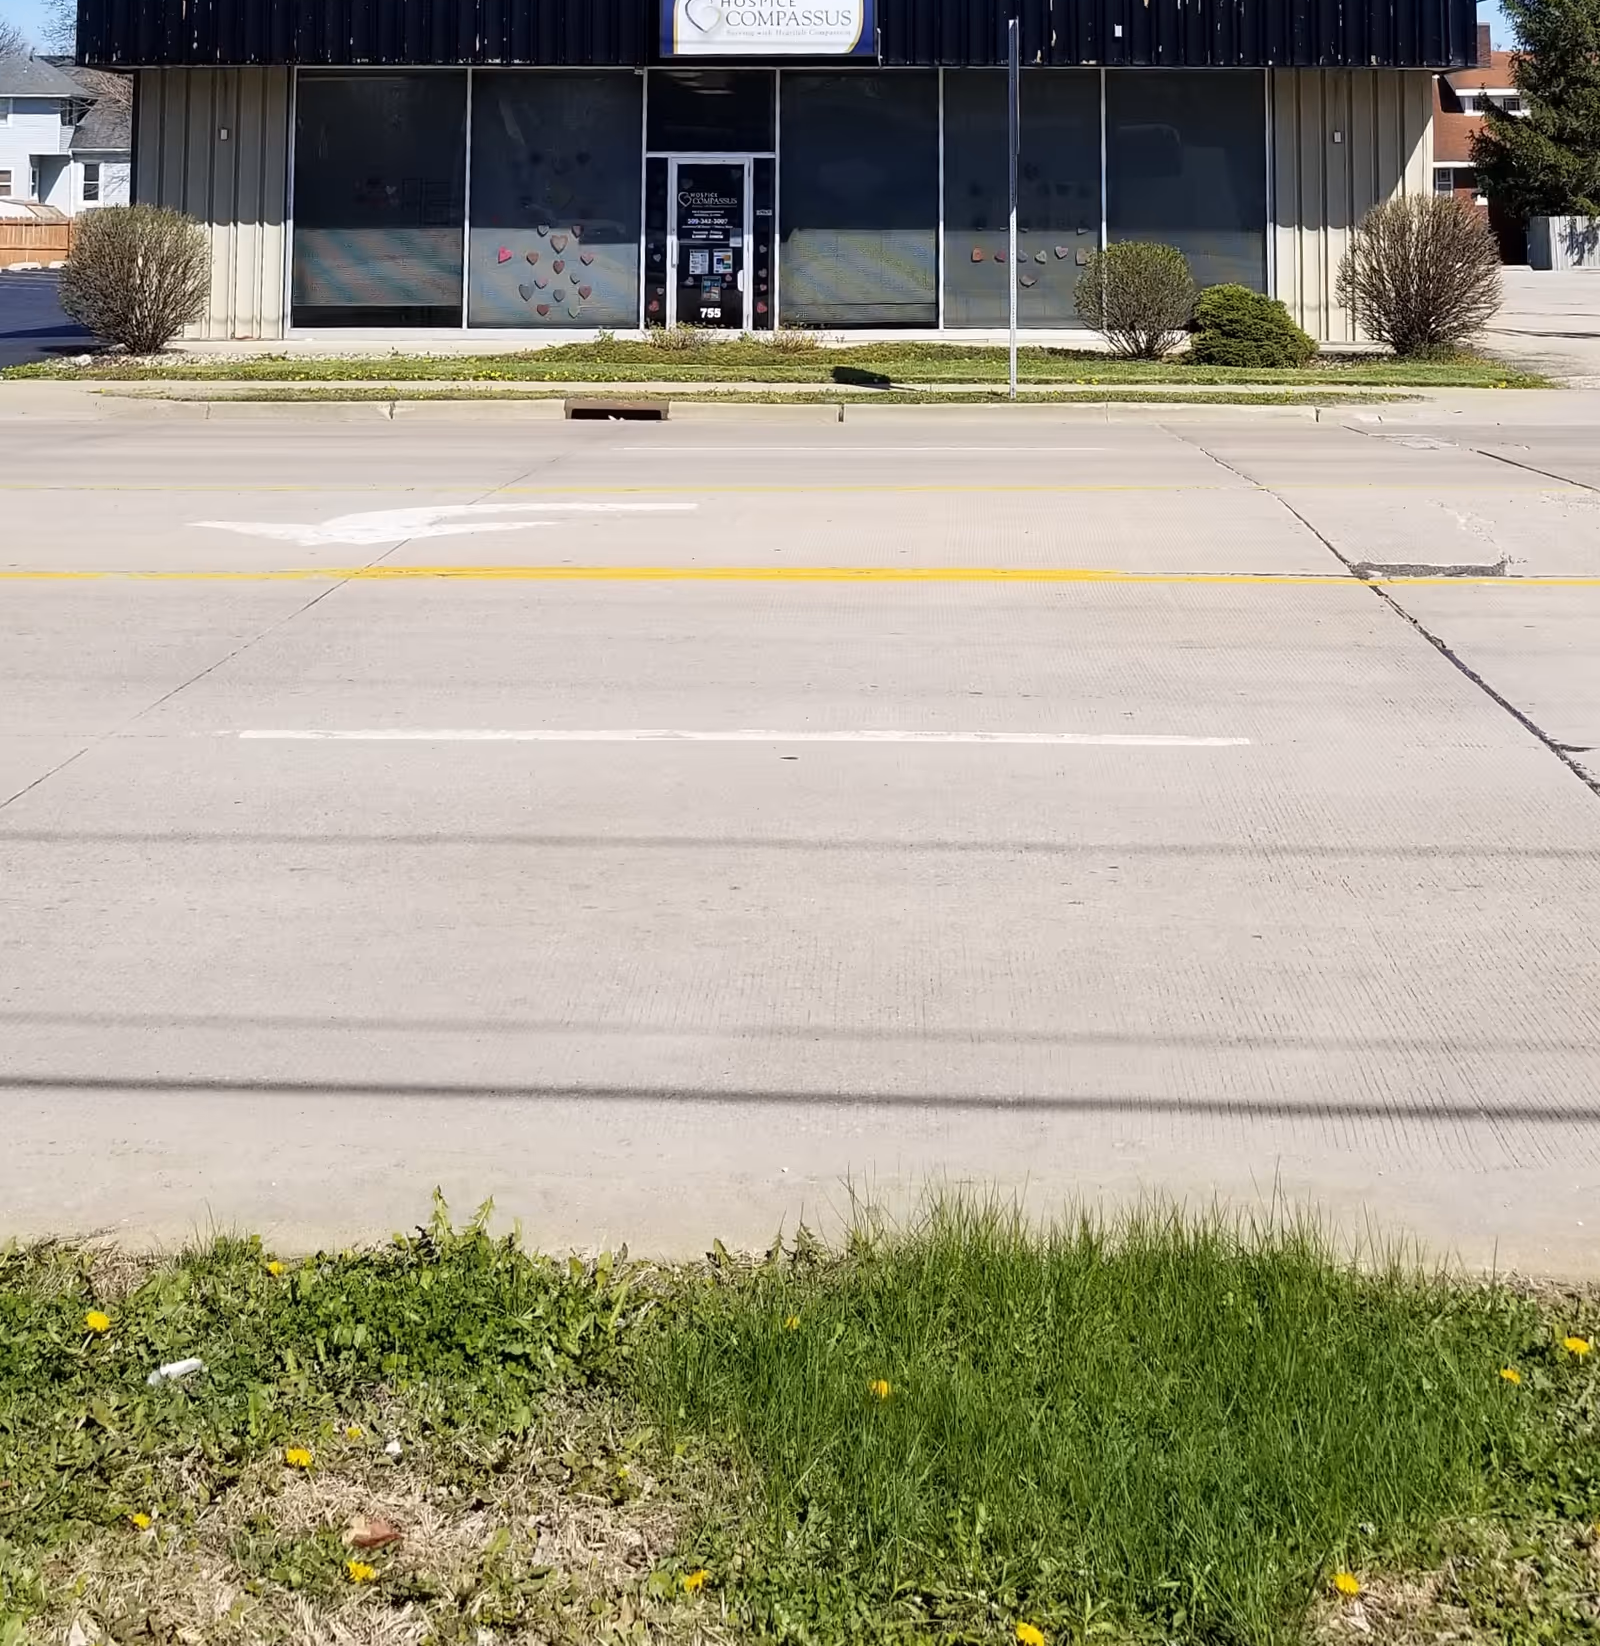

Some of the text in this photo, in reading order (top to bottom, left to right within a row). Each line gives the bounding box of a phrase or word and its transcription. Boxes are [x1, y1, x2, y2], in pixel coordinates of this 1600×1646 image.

[725, 9, 852, 27] COMPASSUS
[692, 197, 738, 205] COMPASSUS
[700, 307, 722, 319] 755
